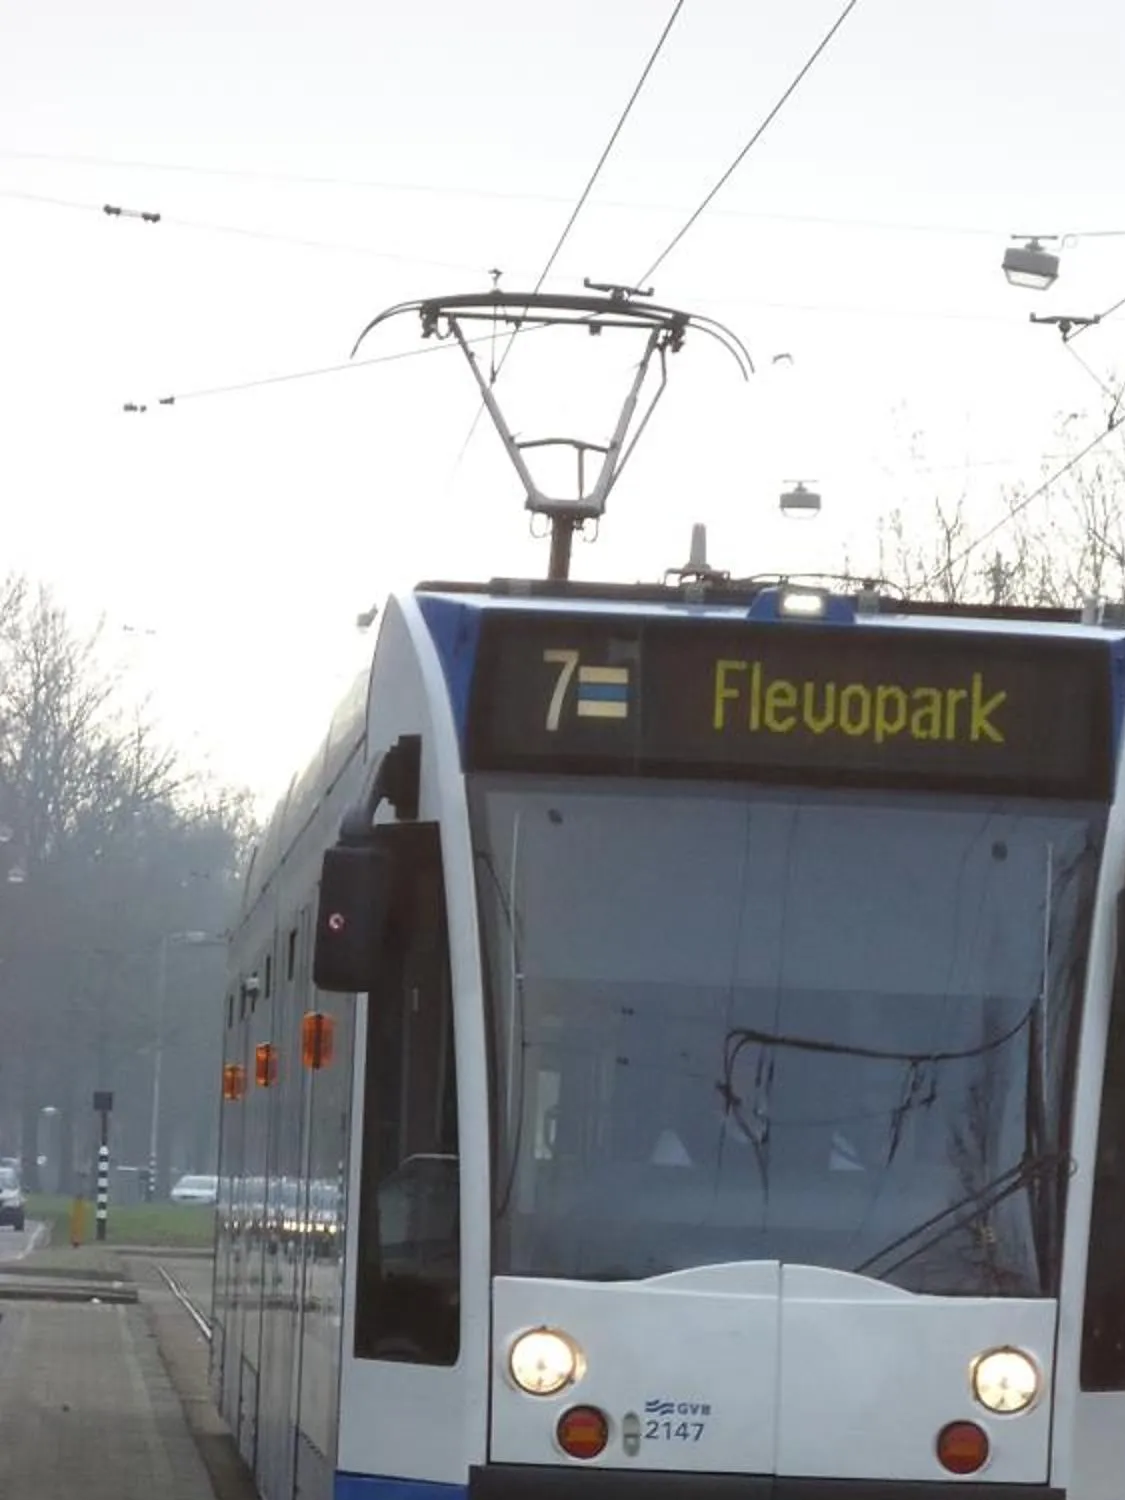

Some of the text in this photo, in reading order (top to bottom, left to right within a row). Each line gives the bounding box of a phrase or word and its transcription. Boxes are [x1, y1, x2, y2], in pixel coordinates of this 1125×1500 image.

[543, 648, 1007, 743] 7 Flevopark
[644, 1419, 705, 1442] 2147
